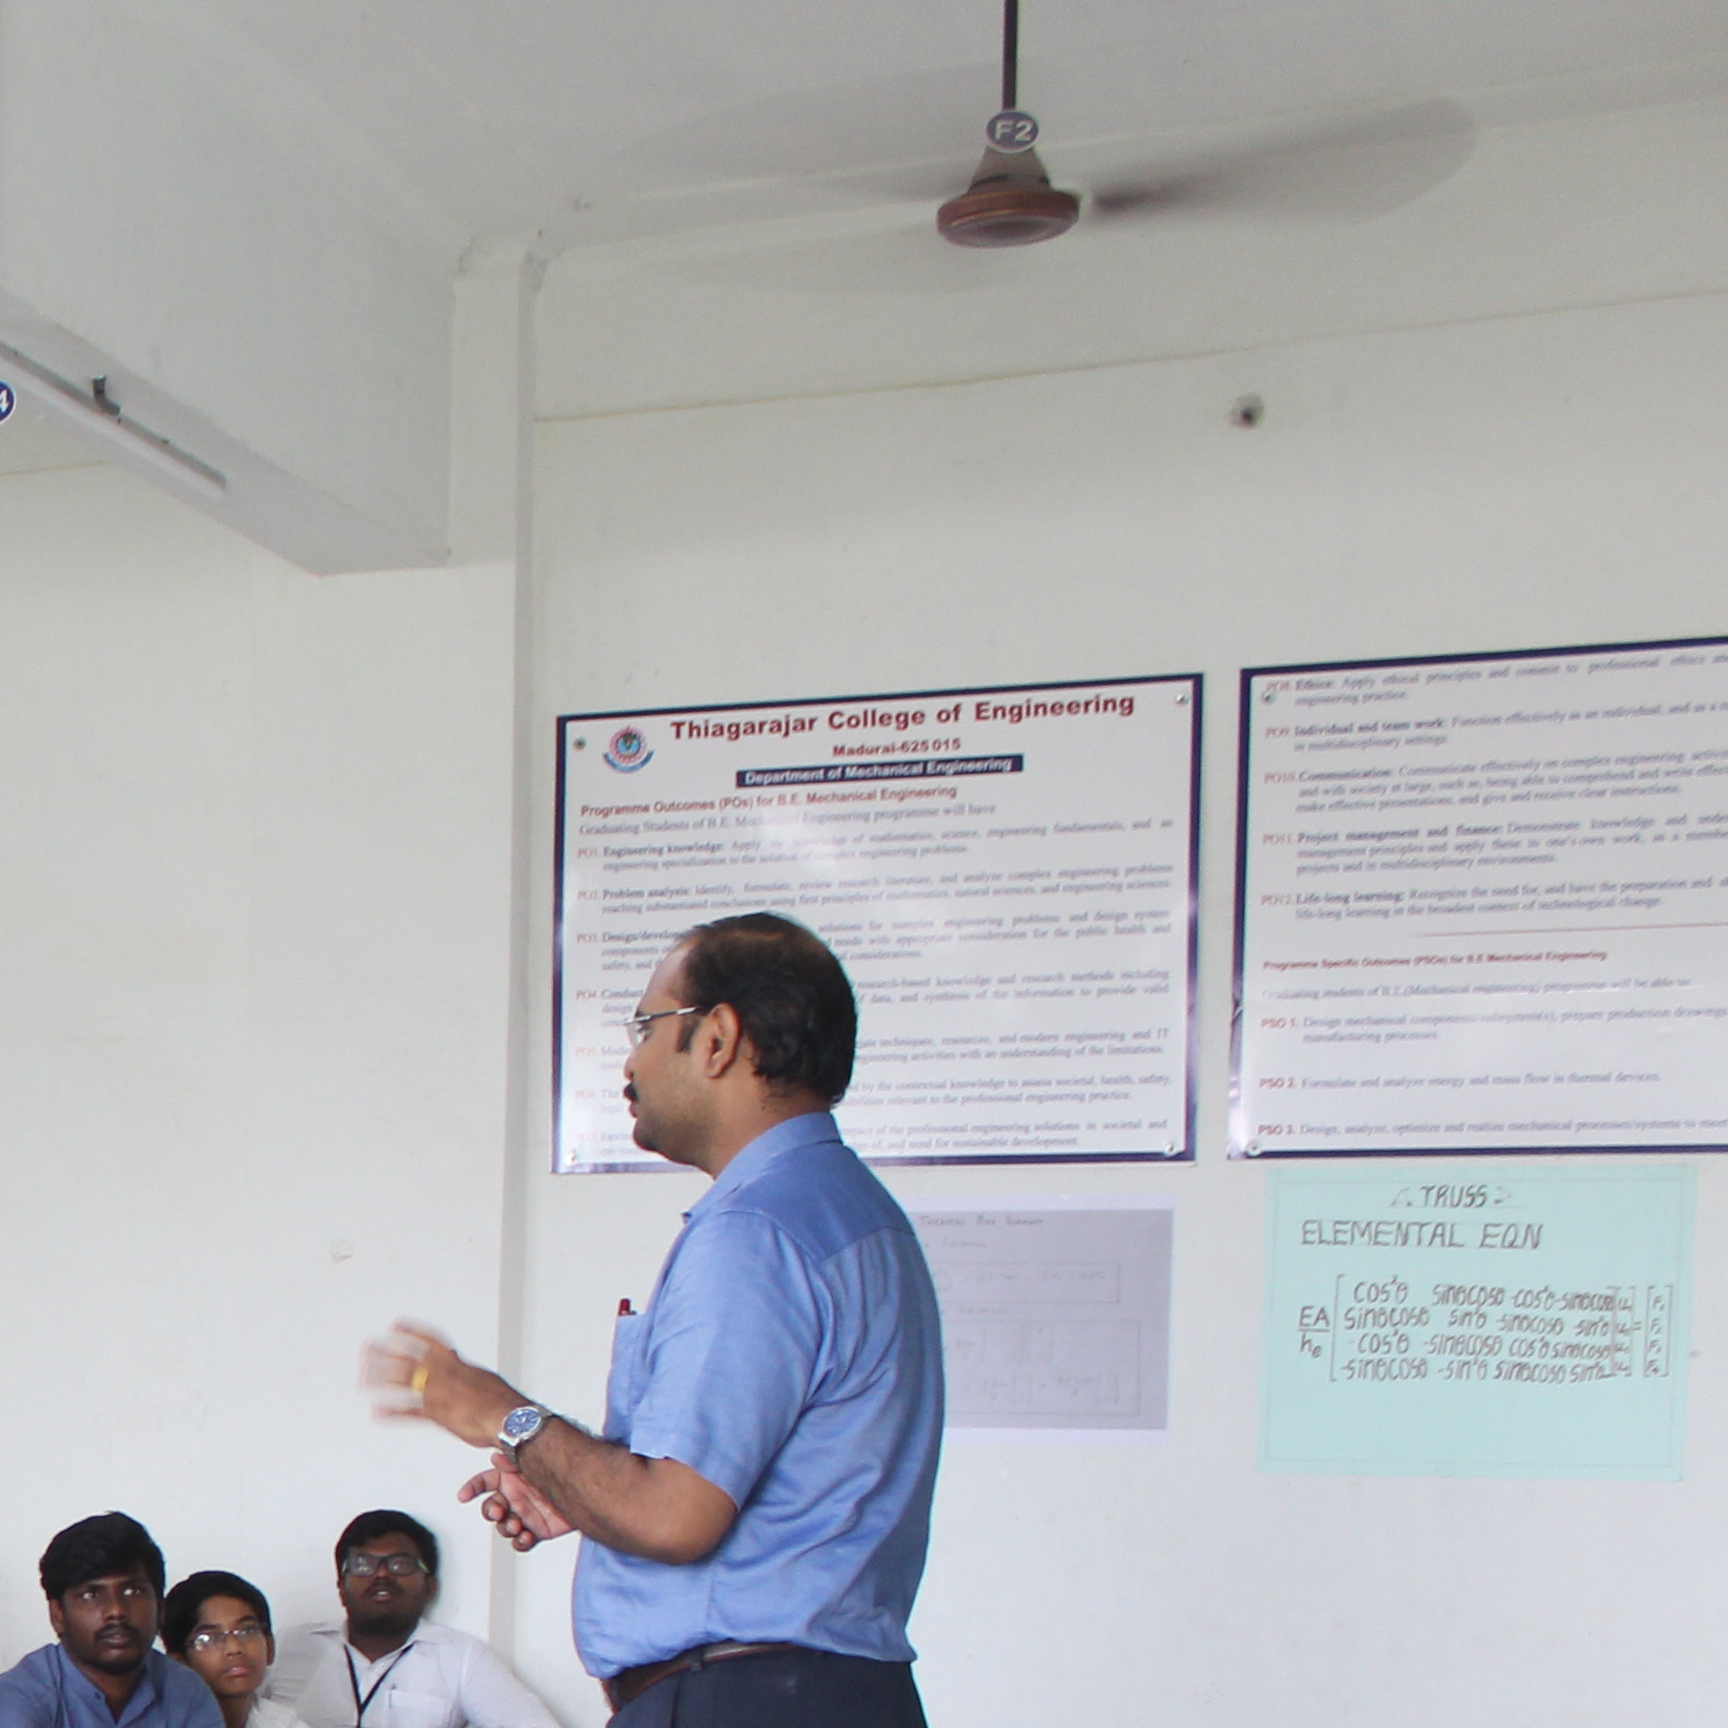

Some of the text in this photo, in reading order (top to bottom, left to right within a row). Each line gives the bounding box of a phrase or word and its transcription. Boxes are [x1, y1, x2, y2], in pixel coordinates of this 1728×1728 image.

[994, 119, 1033, 142] F2
[671, 695, 1135, 741] Thiagarajar College of Engineering
[745, 758, 1012, 785] Department of Mechanical Engineering
[581, 804, 650, 818] Programme
[654, 800, 715, 813] Outcomes
[720, 797, 753, 811] (POs)
[756, 795, 774, 807] for
[806, 788, 878, 803] Mechanical
[881, 786, 957, 801] Engineering
[603, 844, 664, 859] Engineering
[1420, 1184, 1487, 1208] TRUSS
[1300, 1219, 1544, 1249] ELEMENTAL EQN
[1299, 1305, 1330, 1327] EA
